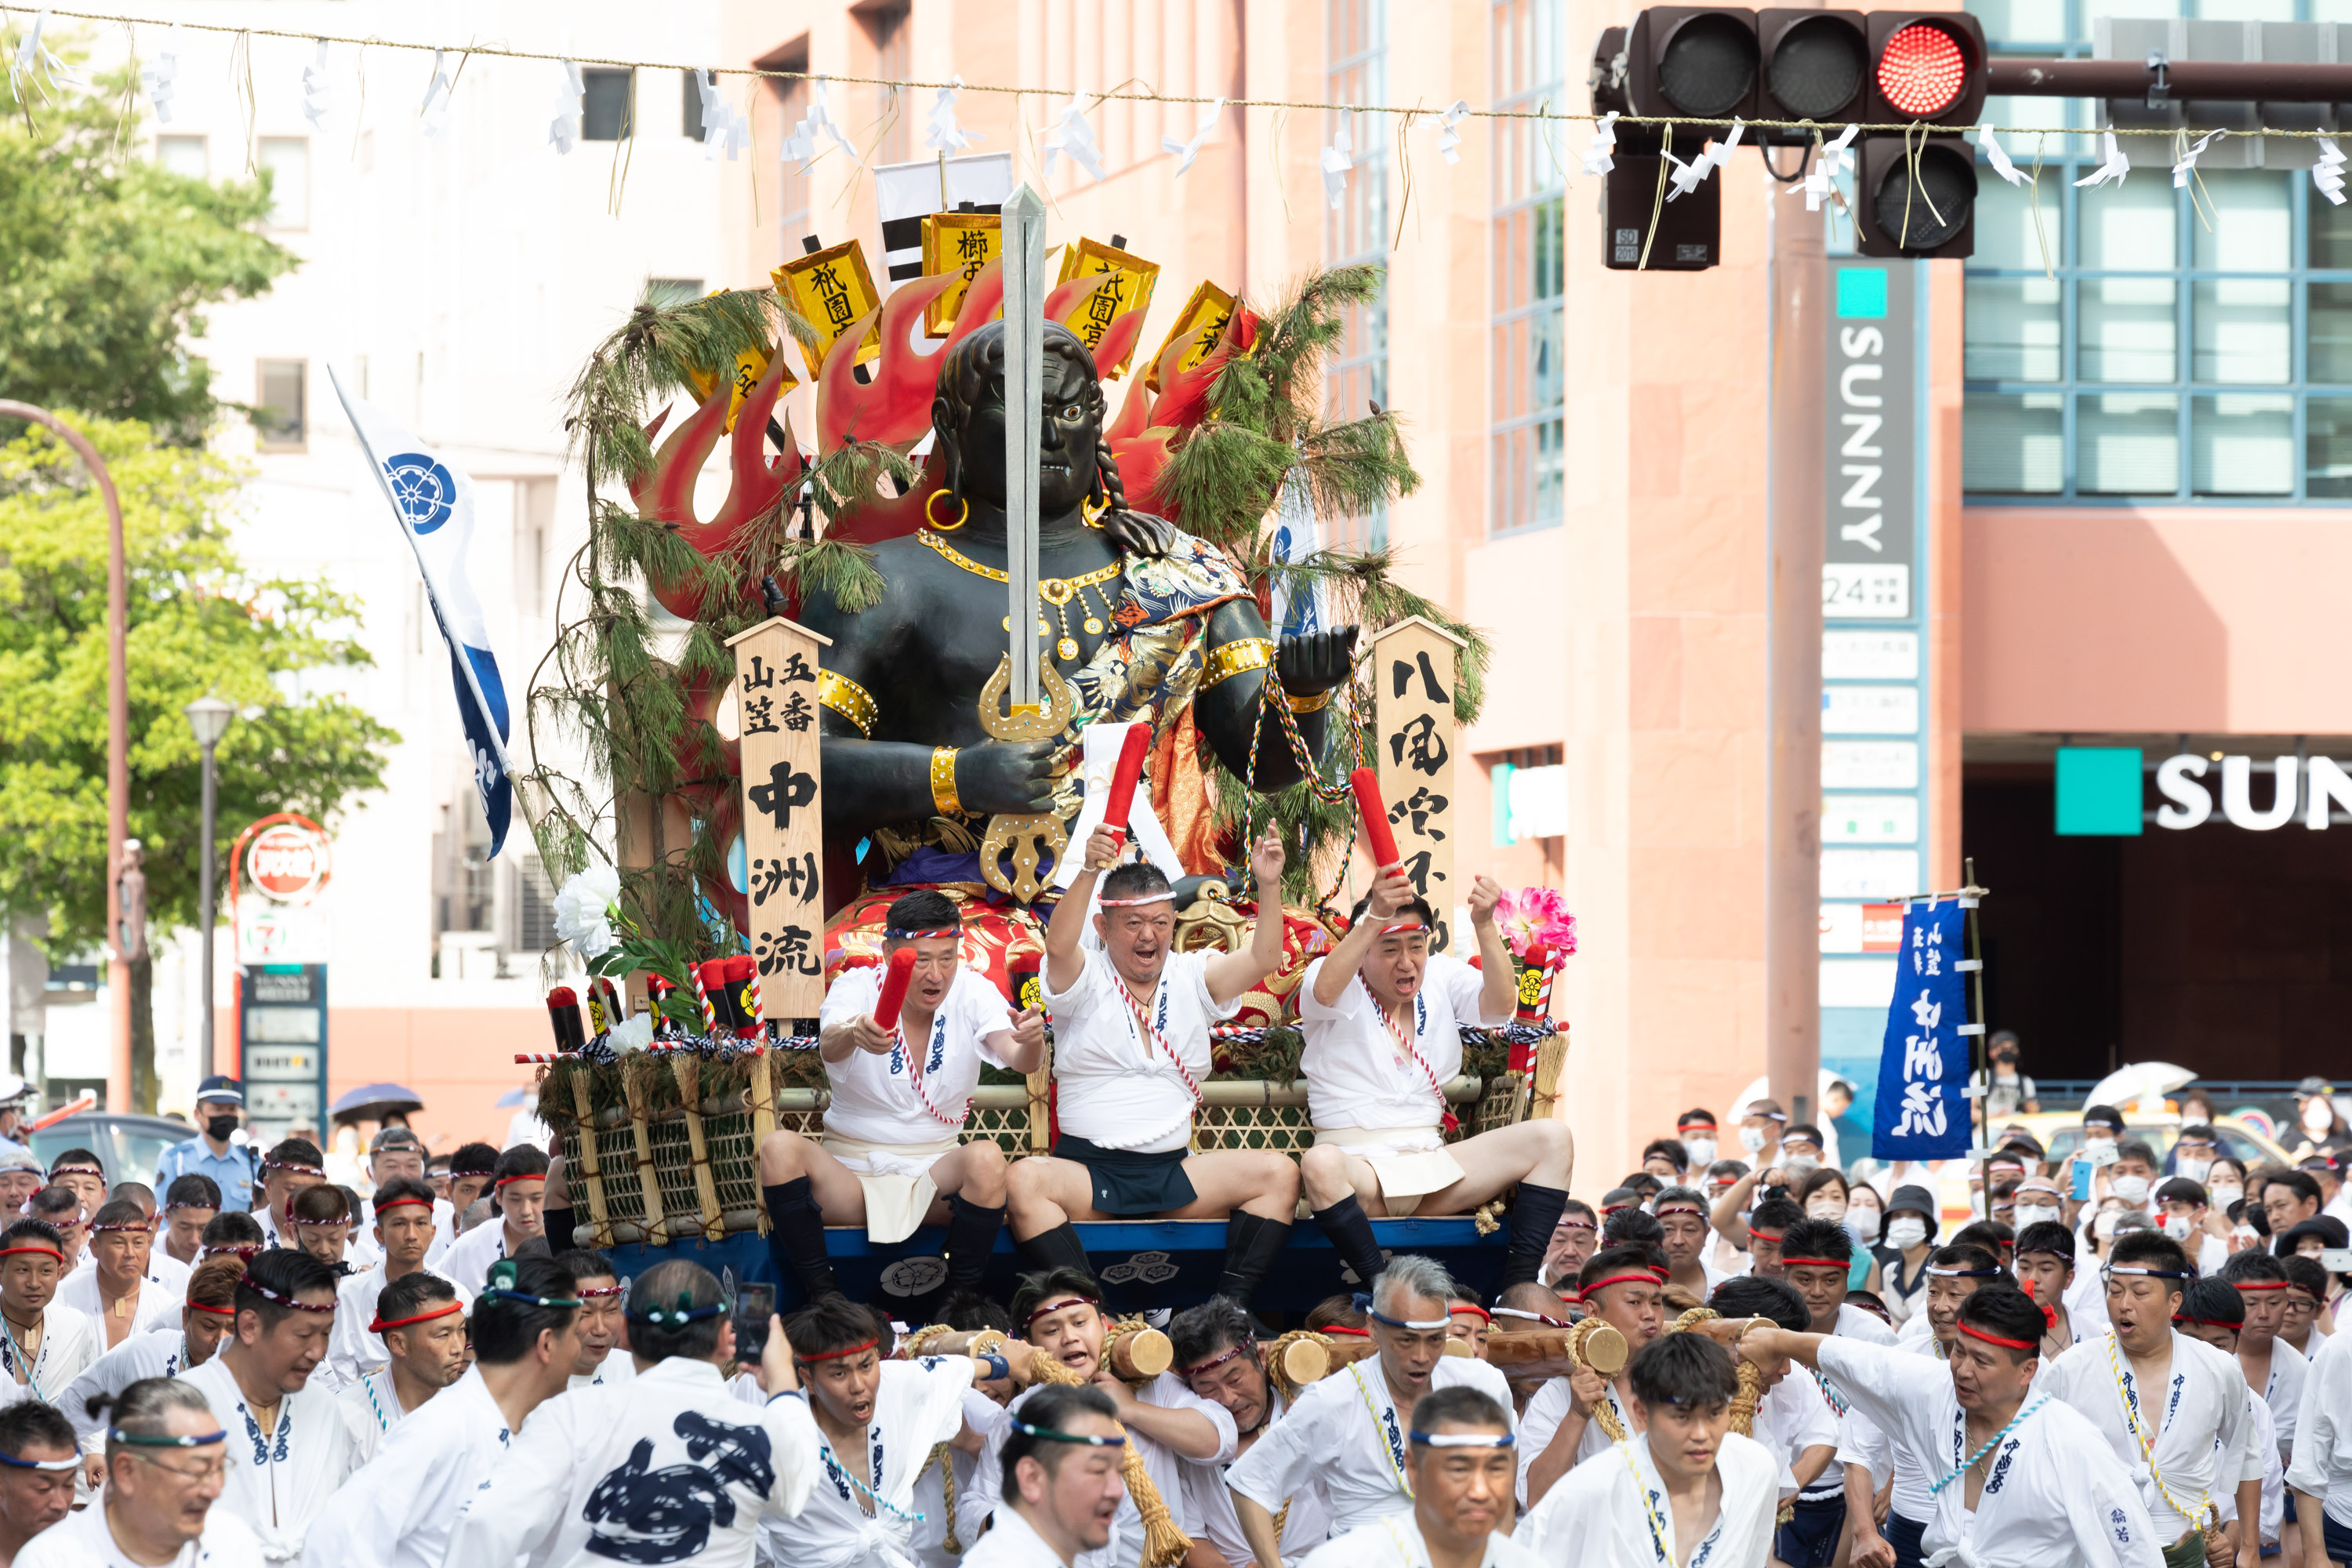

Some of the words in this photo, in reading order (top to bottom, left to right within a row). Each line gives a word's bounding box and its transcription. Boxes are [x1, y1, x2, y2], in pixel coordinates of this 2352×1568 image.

[956, 230, 988, 296] 櫛田
[1617, 247, 1637, 260] 2013
[1620, 230, 1635, 243] SD
[1839, 326, 1884, 553] SUNNY
[742, 655, 780, 736] 山笠
[779, 652, 816, 732] 五番
[2156, 753, 2352, 831] SUN
[748, 760, 822, 978] 中洲流
